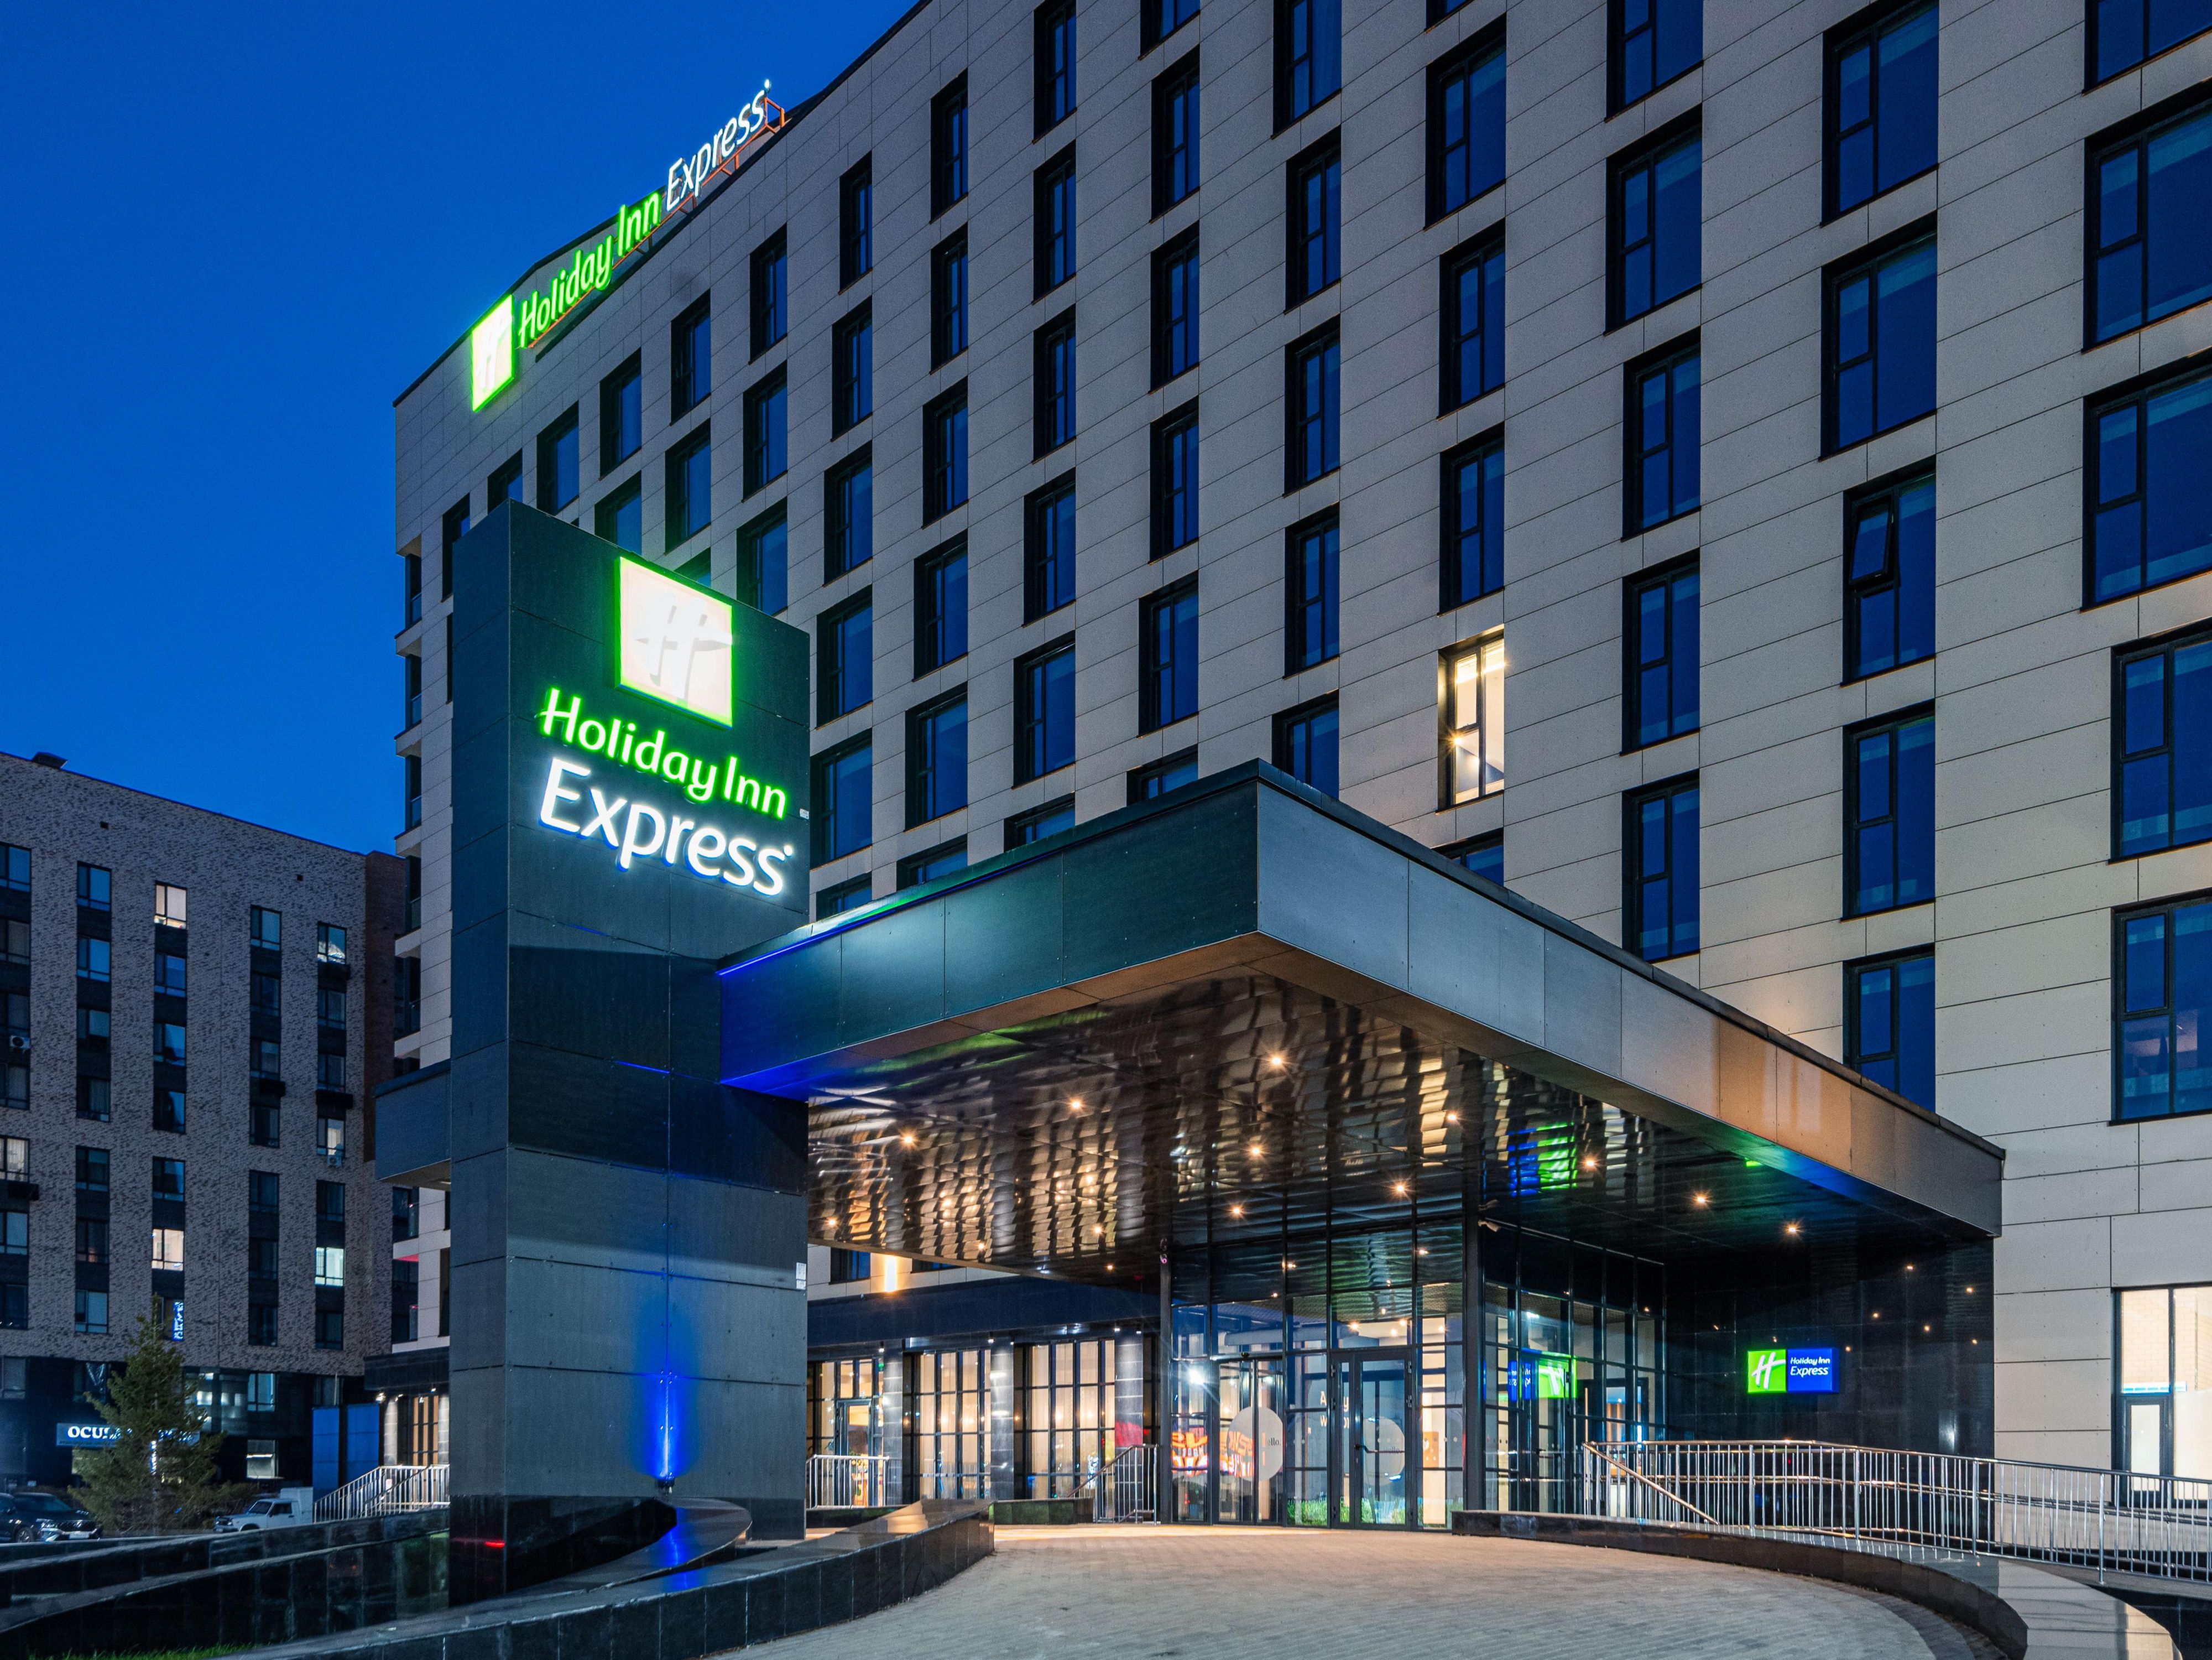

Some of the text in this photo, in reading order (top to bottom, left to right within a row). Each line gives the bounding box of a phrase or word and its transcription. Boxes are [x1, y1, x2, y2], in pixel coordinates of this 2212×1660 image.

[518, 90, 765, 348] Holiday Inn Express
[537, 688, 787, 819] Holiday Inn
[540, 757, 787, 896] Express
[1790, 1356, 1818, 1366] Holiday
[1790, 1366, 1829, 1378] Express
